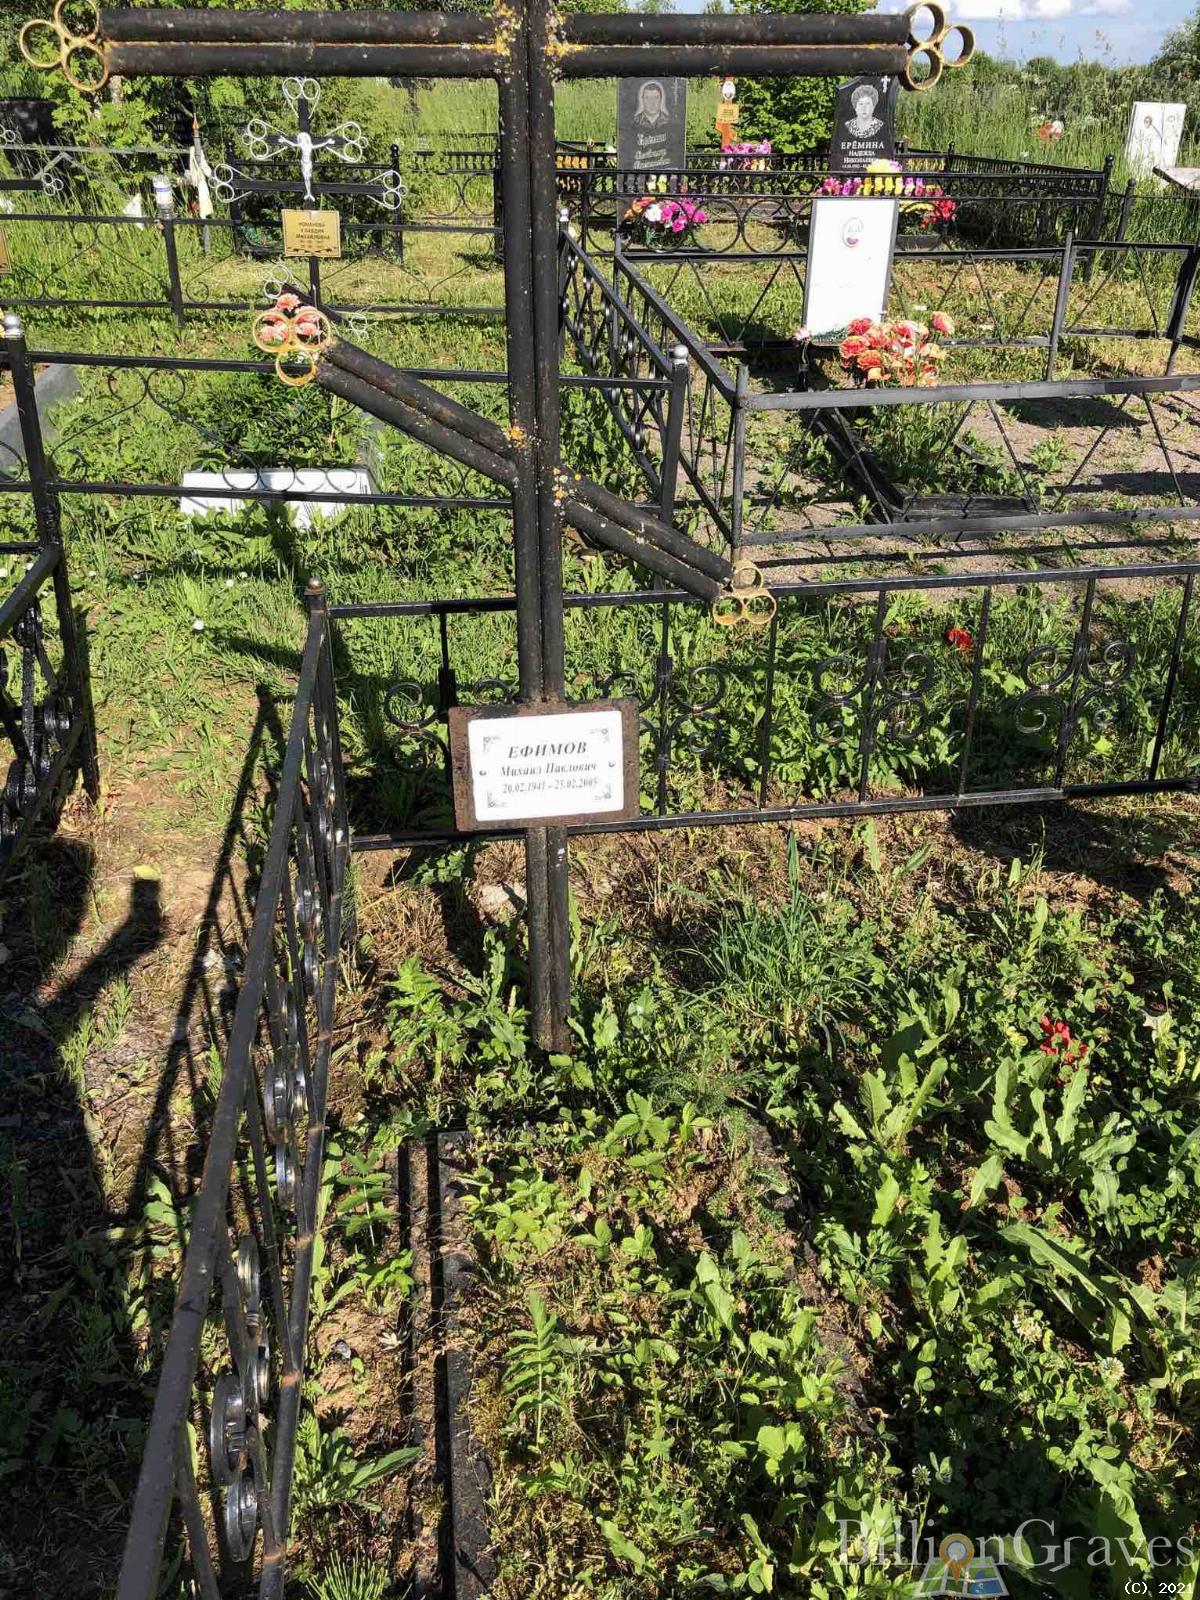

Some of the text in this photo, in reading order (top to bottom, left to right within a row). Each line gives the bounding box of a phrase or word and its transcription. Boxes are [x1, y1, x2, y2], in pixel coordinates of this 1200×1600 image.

[841, 140, 885, 149] ЕРЁМИНА
[508, 741, 587, 759] ЕФИМОВ
[501, 762, 598, 777] Михаил Павлович
